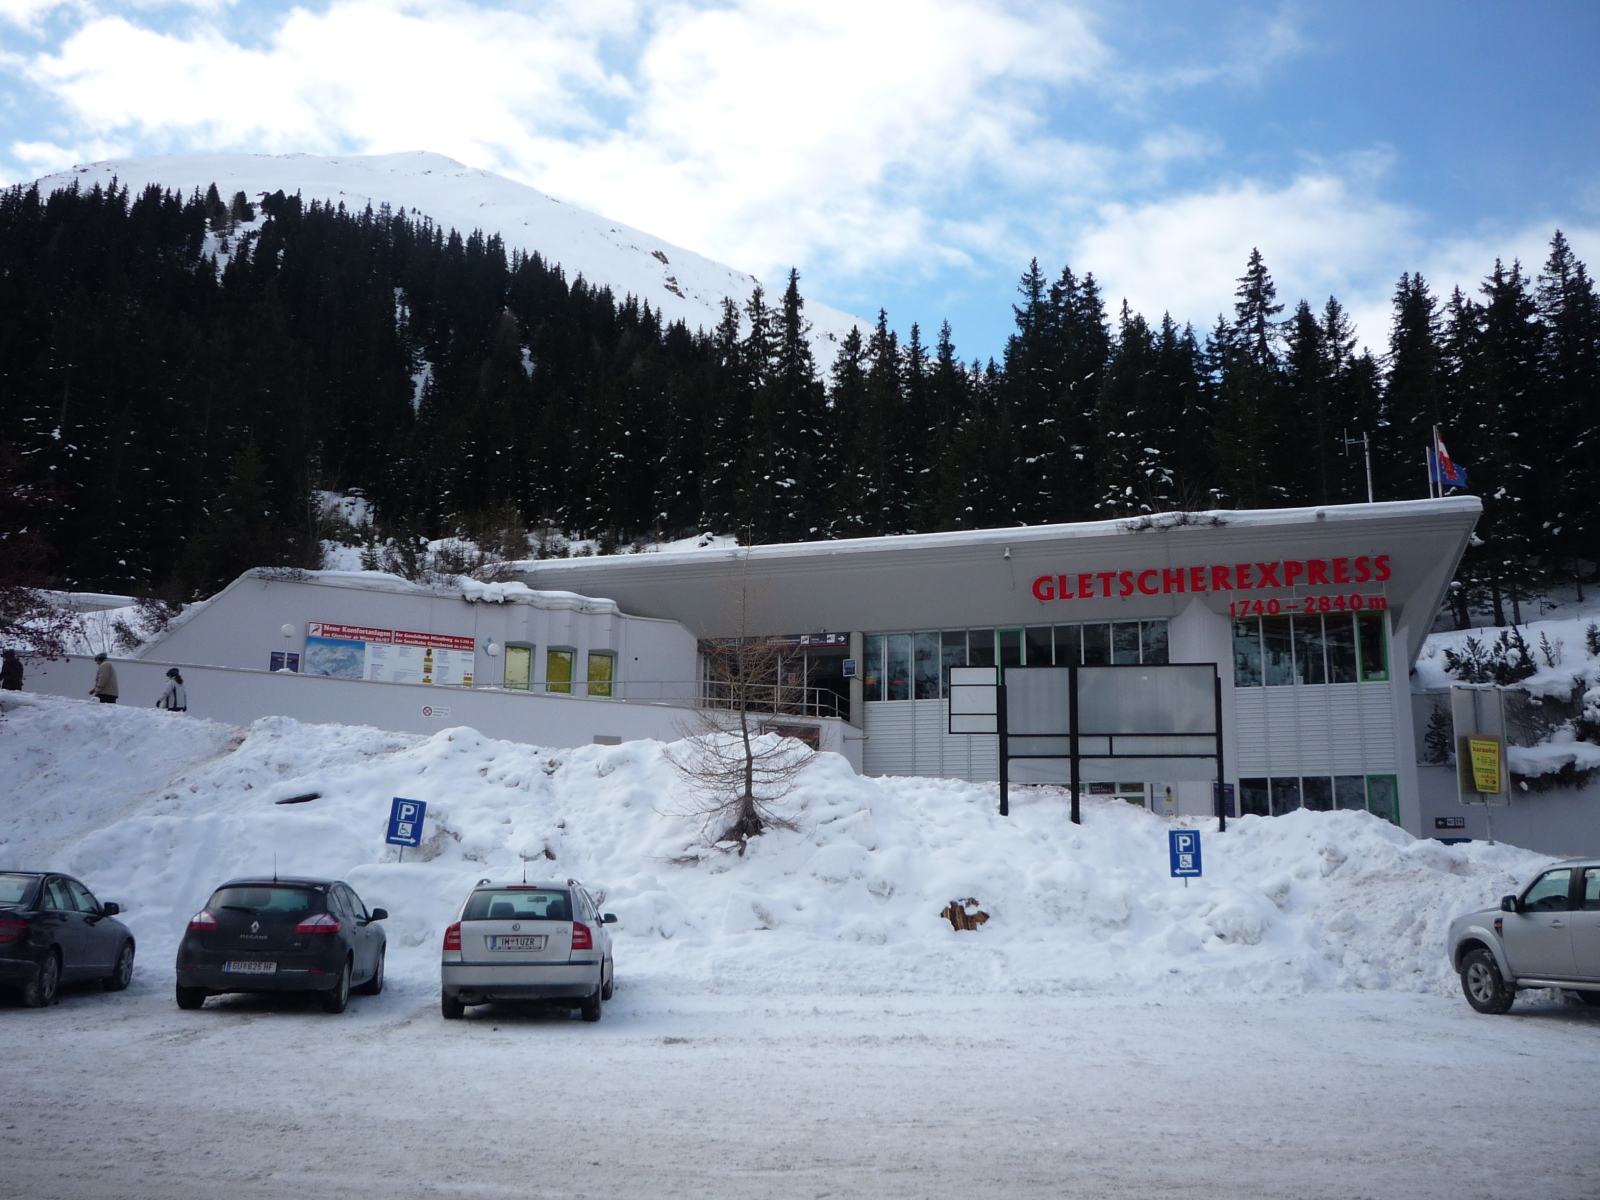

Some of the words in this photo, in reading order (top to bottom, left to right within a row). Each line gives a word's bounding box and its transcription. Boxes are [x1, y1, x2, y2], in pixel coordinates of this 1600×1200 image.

[1032, 555, 1391, 600] GLETSCHEREXPRESS
[1229, 599, 1280, 617] 1740
[1304, 594, 1363, 613] 2840
[1368, 597, 1387, 609] m
[323, 624, 340, 632] Neue
[342, 626, 391, 637] Komfortanlagen
[1472, 746, 1496, 754] karaoke
[400, 804, 415, 820] P
[1179, 836, 1191, 851] P
